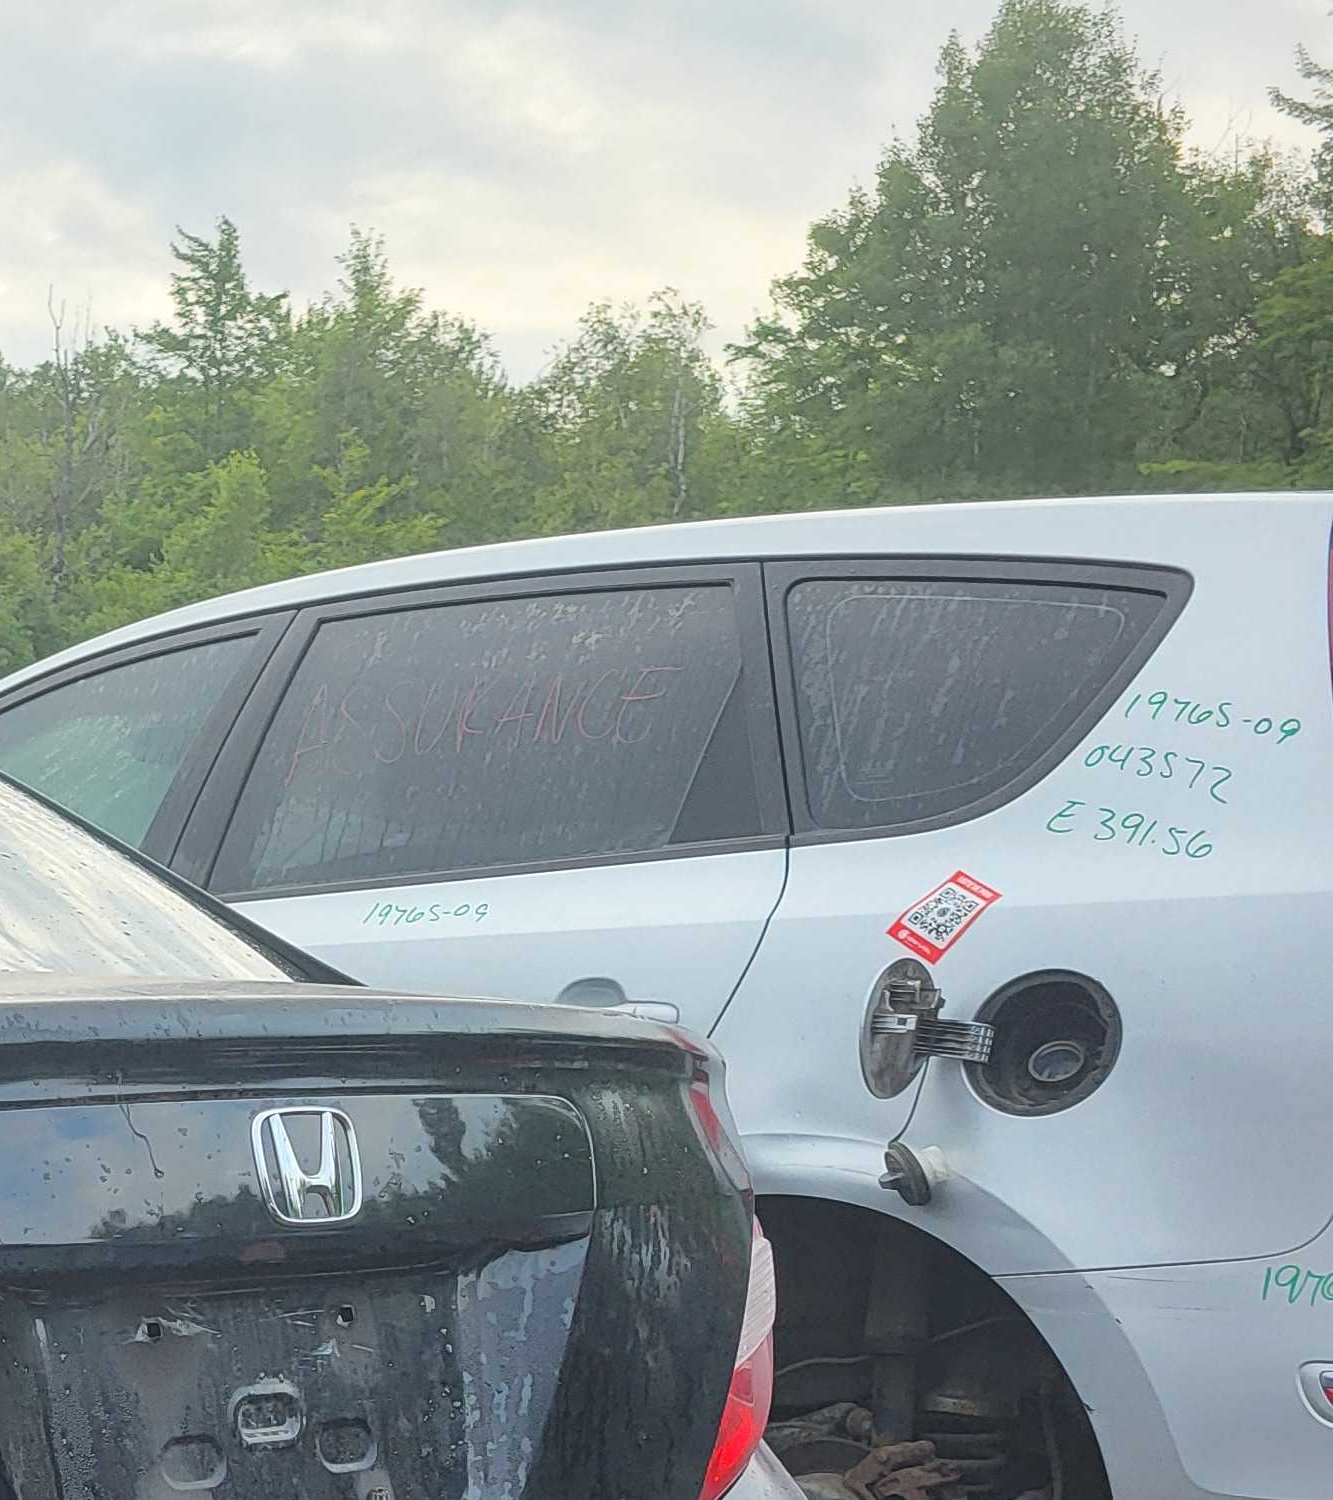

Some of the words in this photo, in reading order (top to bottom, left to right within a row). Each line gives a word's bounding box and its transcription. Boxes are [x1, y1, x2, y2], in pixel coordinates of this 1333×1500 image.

[1125, 691, 1301, 744] 19765-09
[1084, 744, 1233, 804] 043572
[1046, 800, 1086, 834] E
